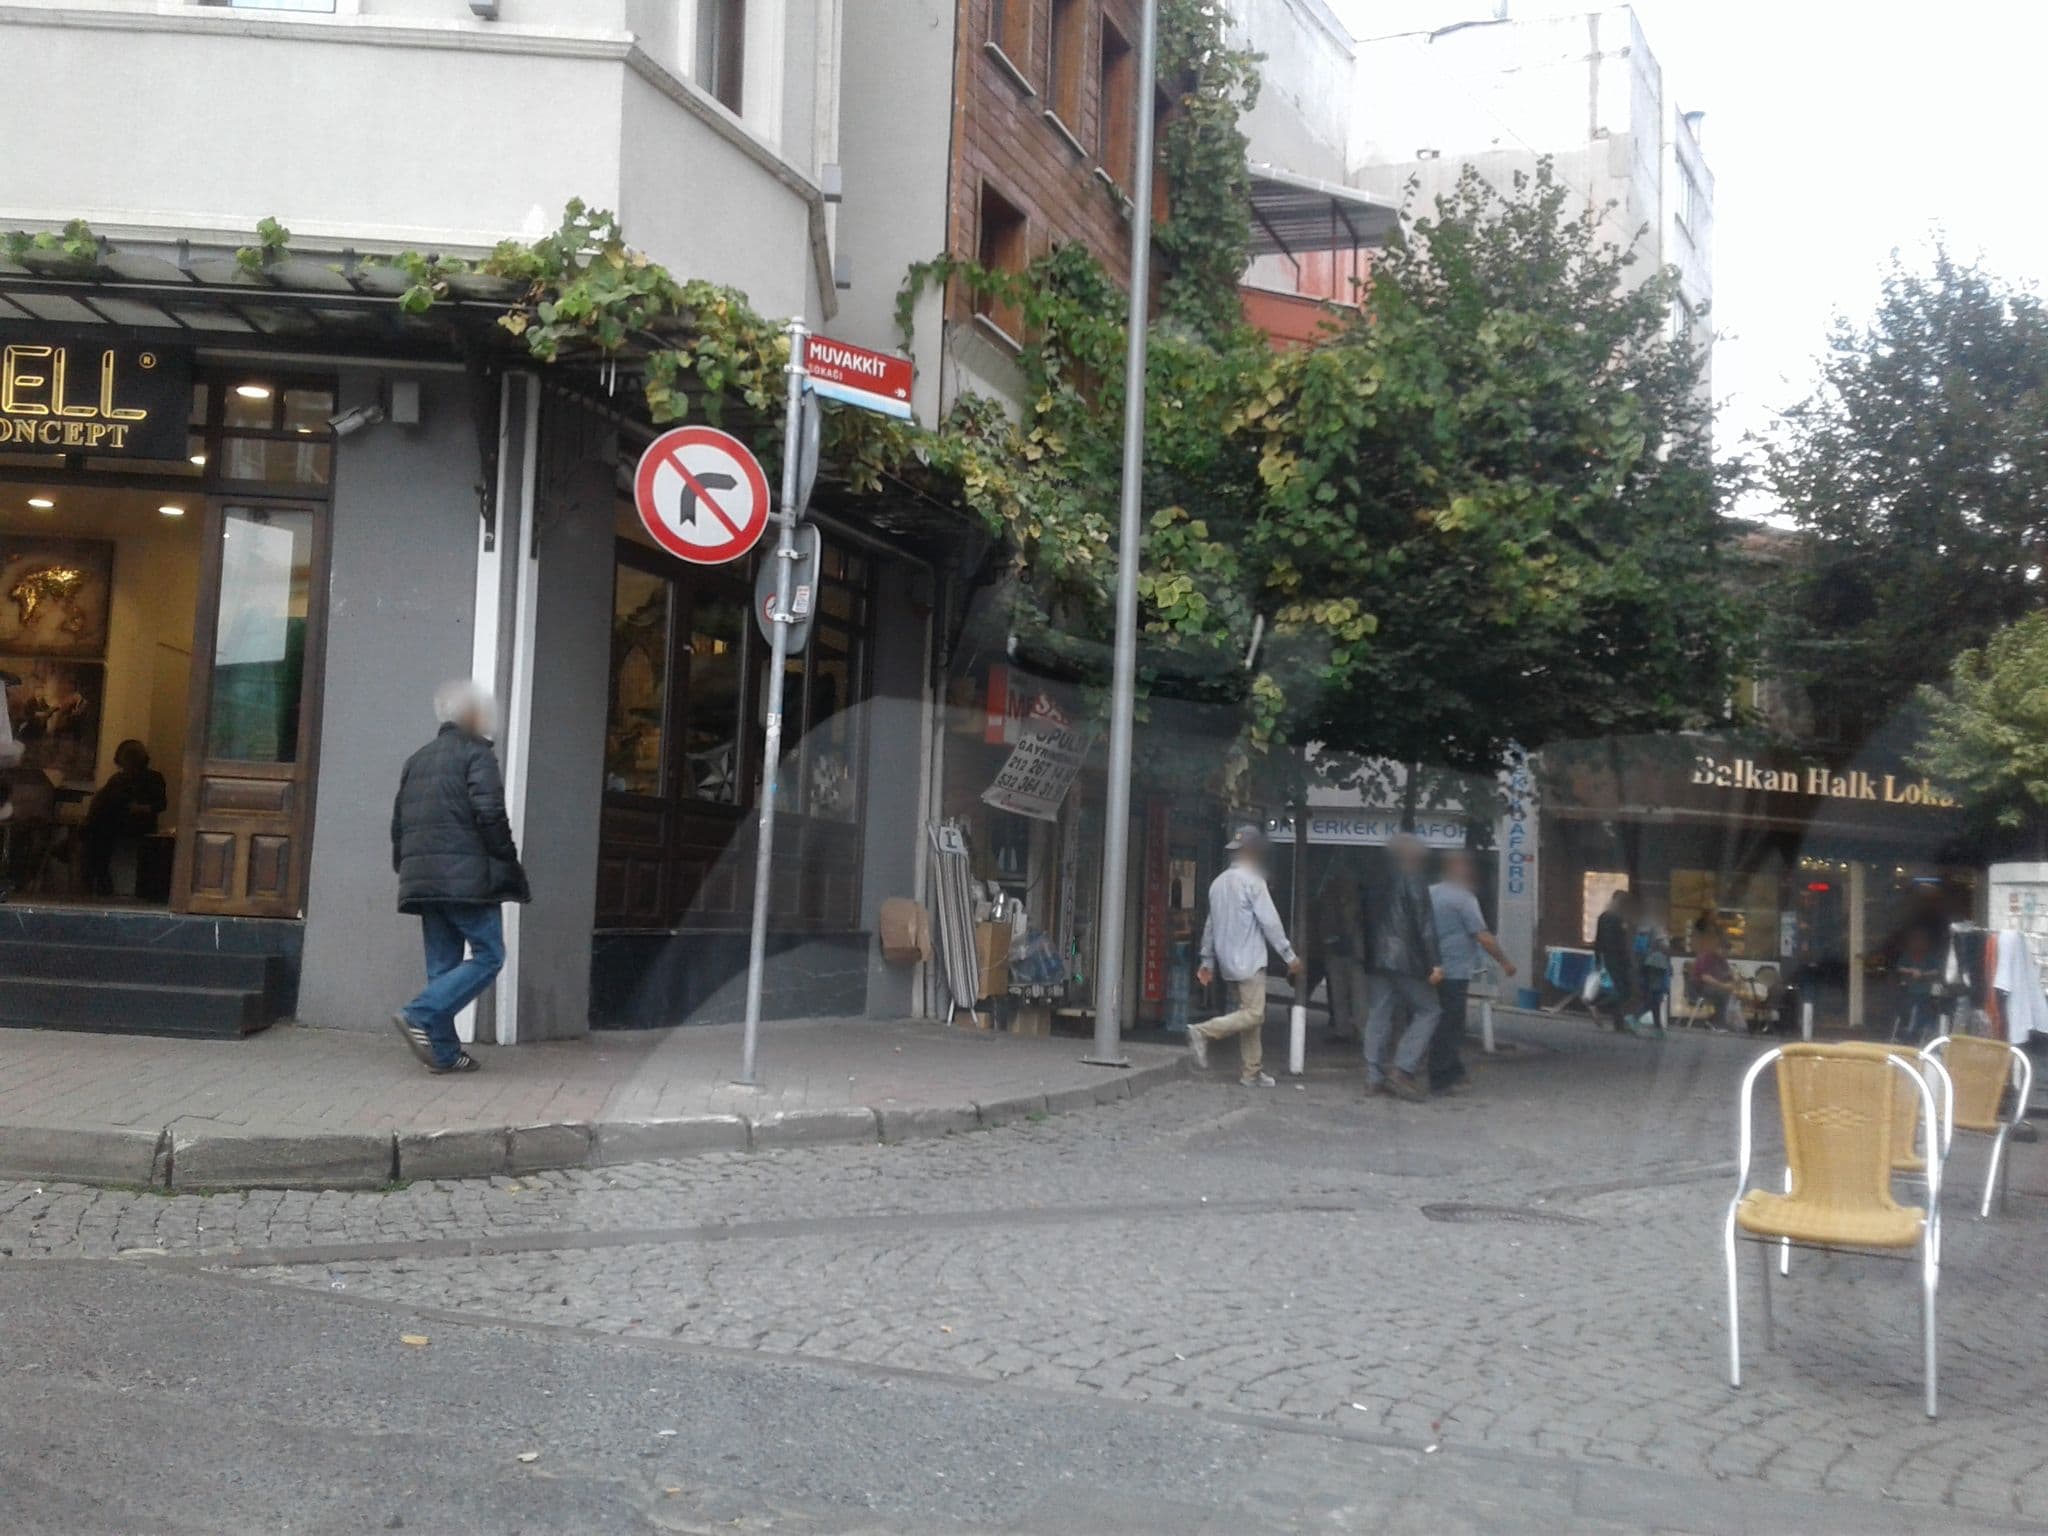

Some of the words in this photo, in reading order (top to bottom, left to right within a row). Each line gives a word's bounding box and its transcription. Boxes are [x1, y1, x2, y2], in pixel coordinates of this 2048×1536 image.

[809, 342, 887, 379] MUVAKKİT
[1691, 756, 1799, 793] Balkan
[1807, 767, 1877, 800] Halk
[1312, 820, 1378, 836] ERKEK
